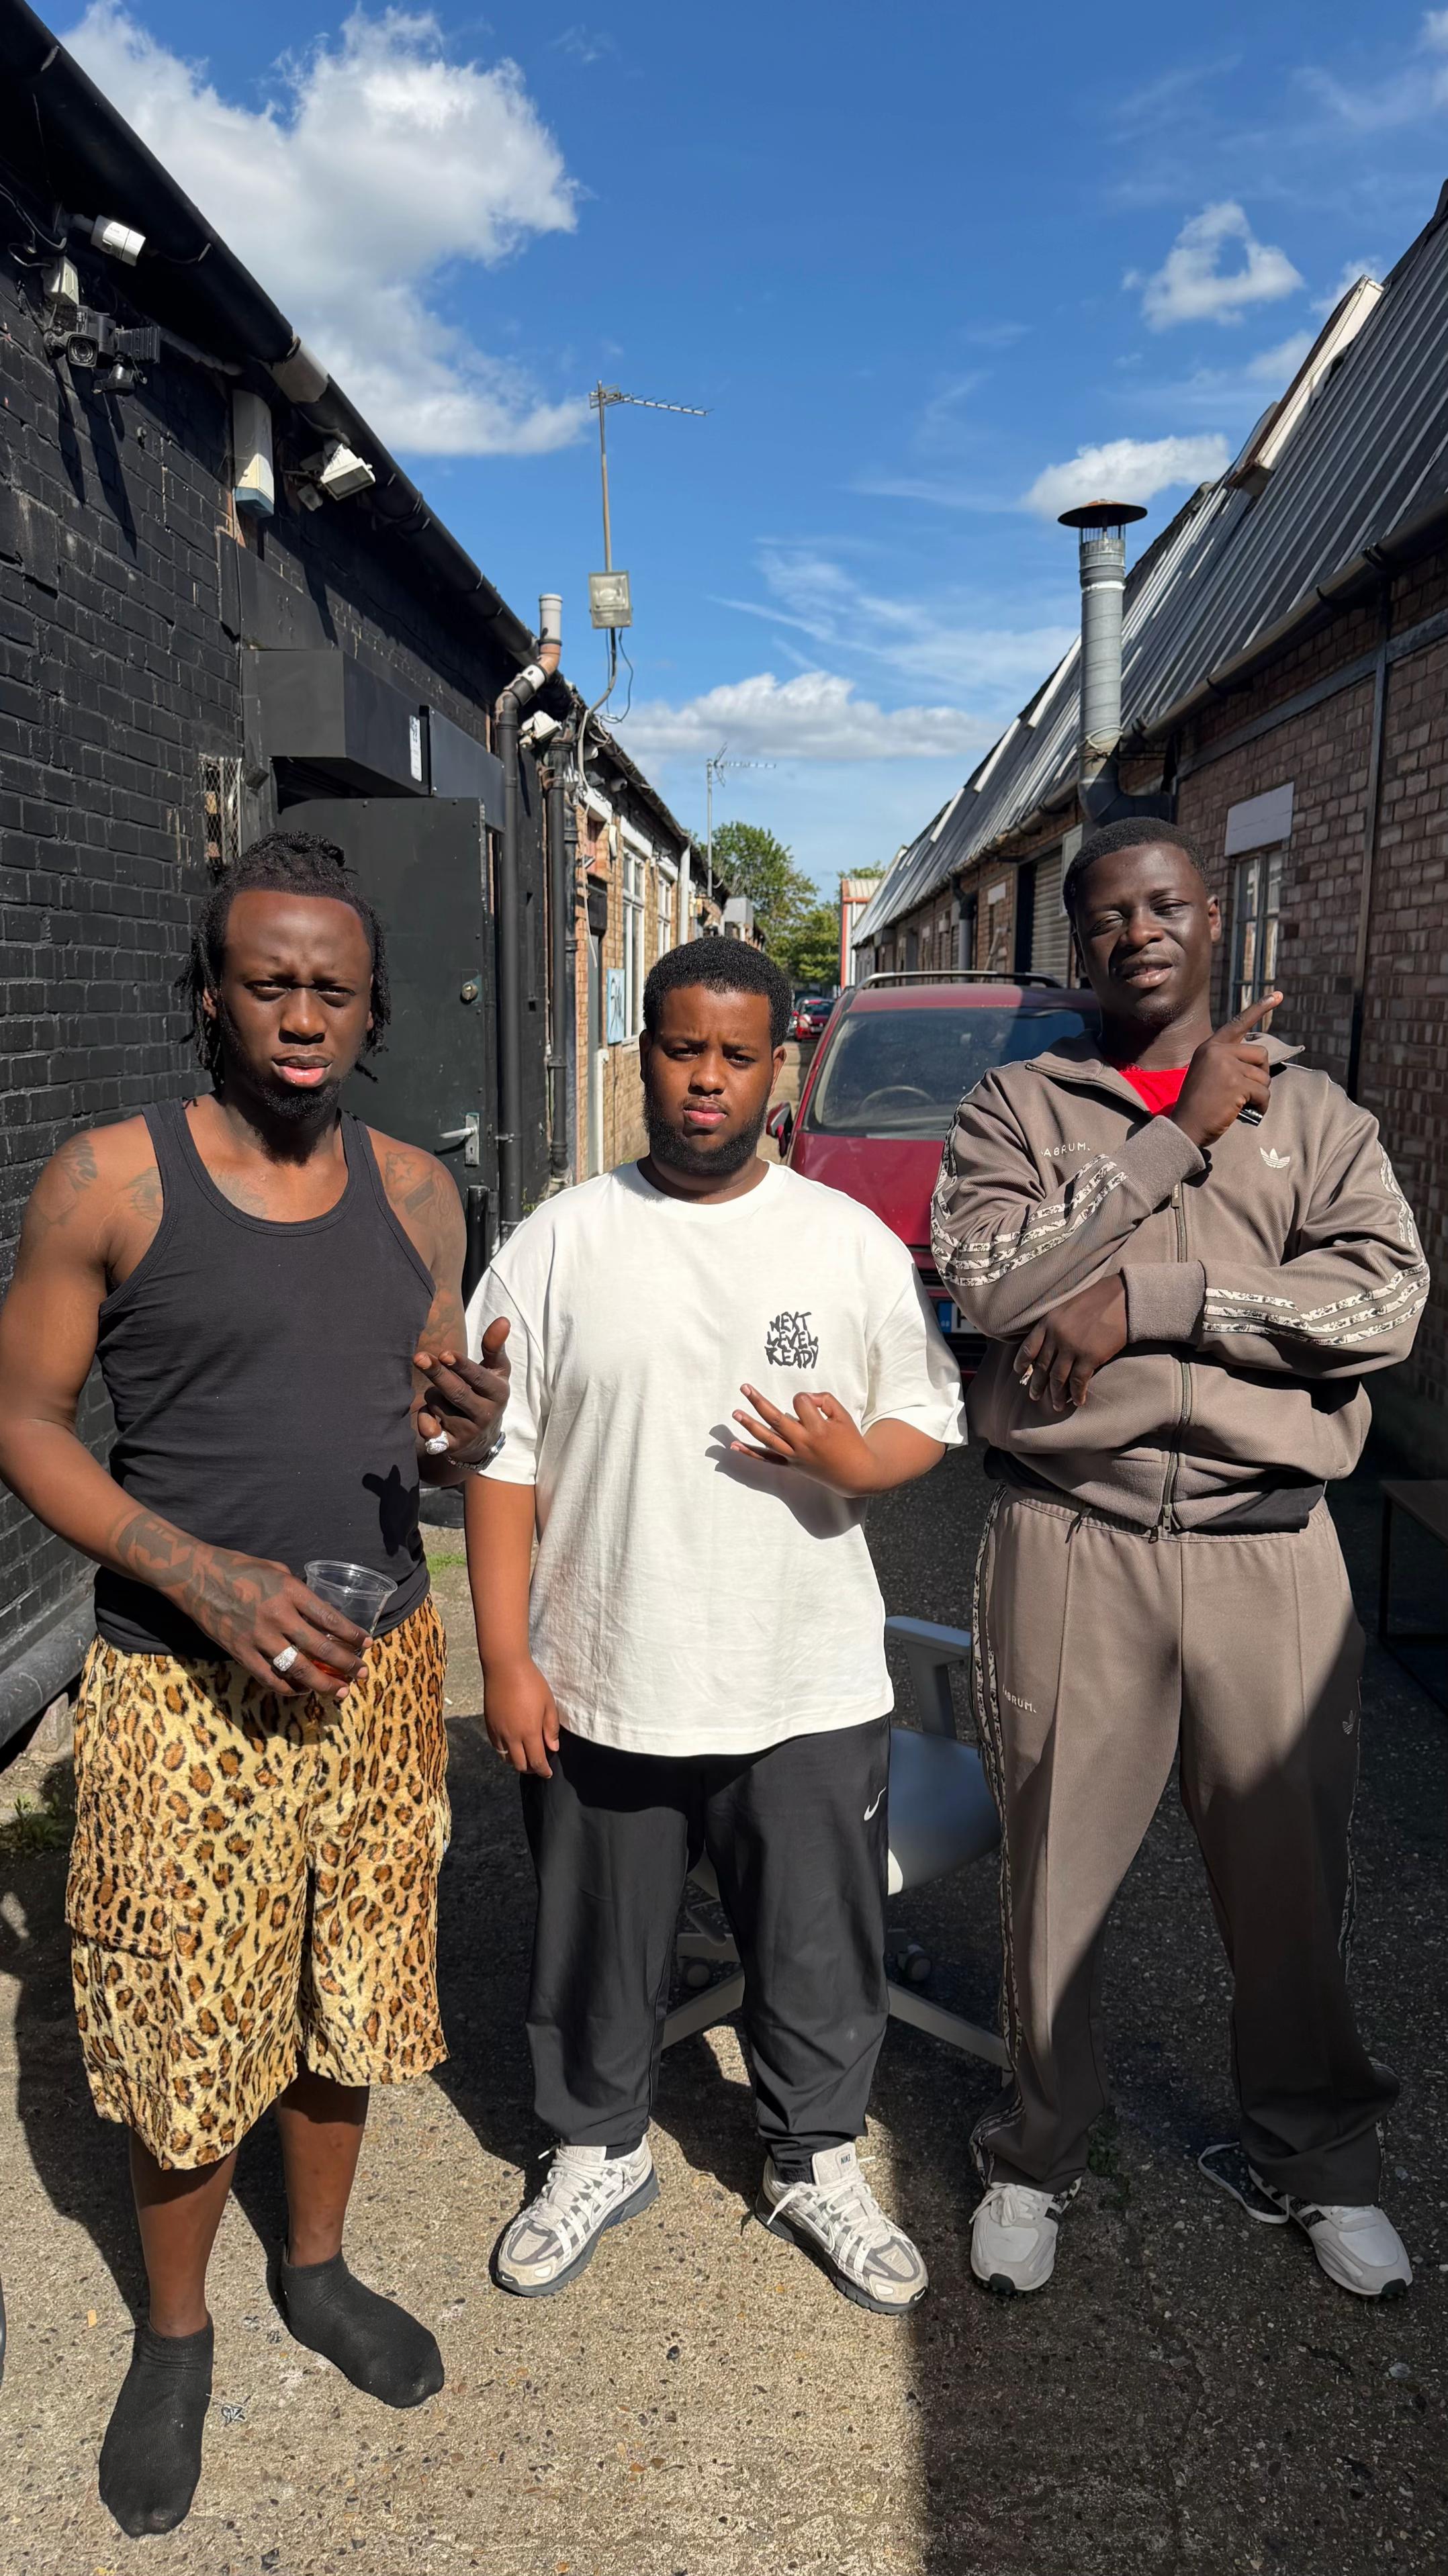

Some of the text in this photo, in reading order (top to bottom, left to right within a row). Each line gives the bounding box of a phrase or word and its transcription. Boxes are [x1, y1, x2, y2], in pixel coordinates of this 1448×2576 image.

[1041, 1142, 1090, 1157] ABRUM.
[769, 1312, 811, 1332] NEXT
[767, 1330, 819, 1350] LEVEL
[764, 1345, 819, 1369] READY
[841, 2154, 851, 2165] NIKE
